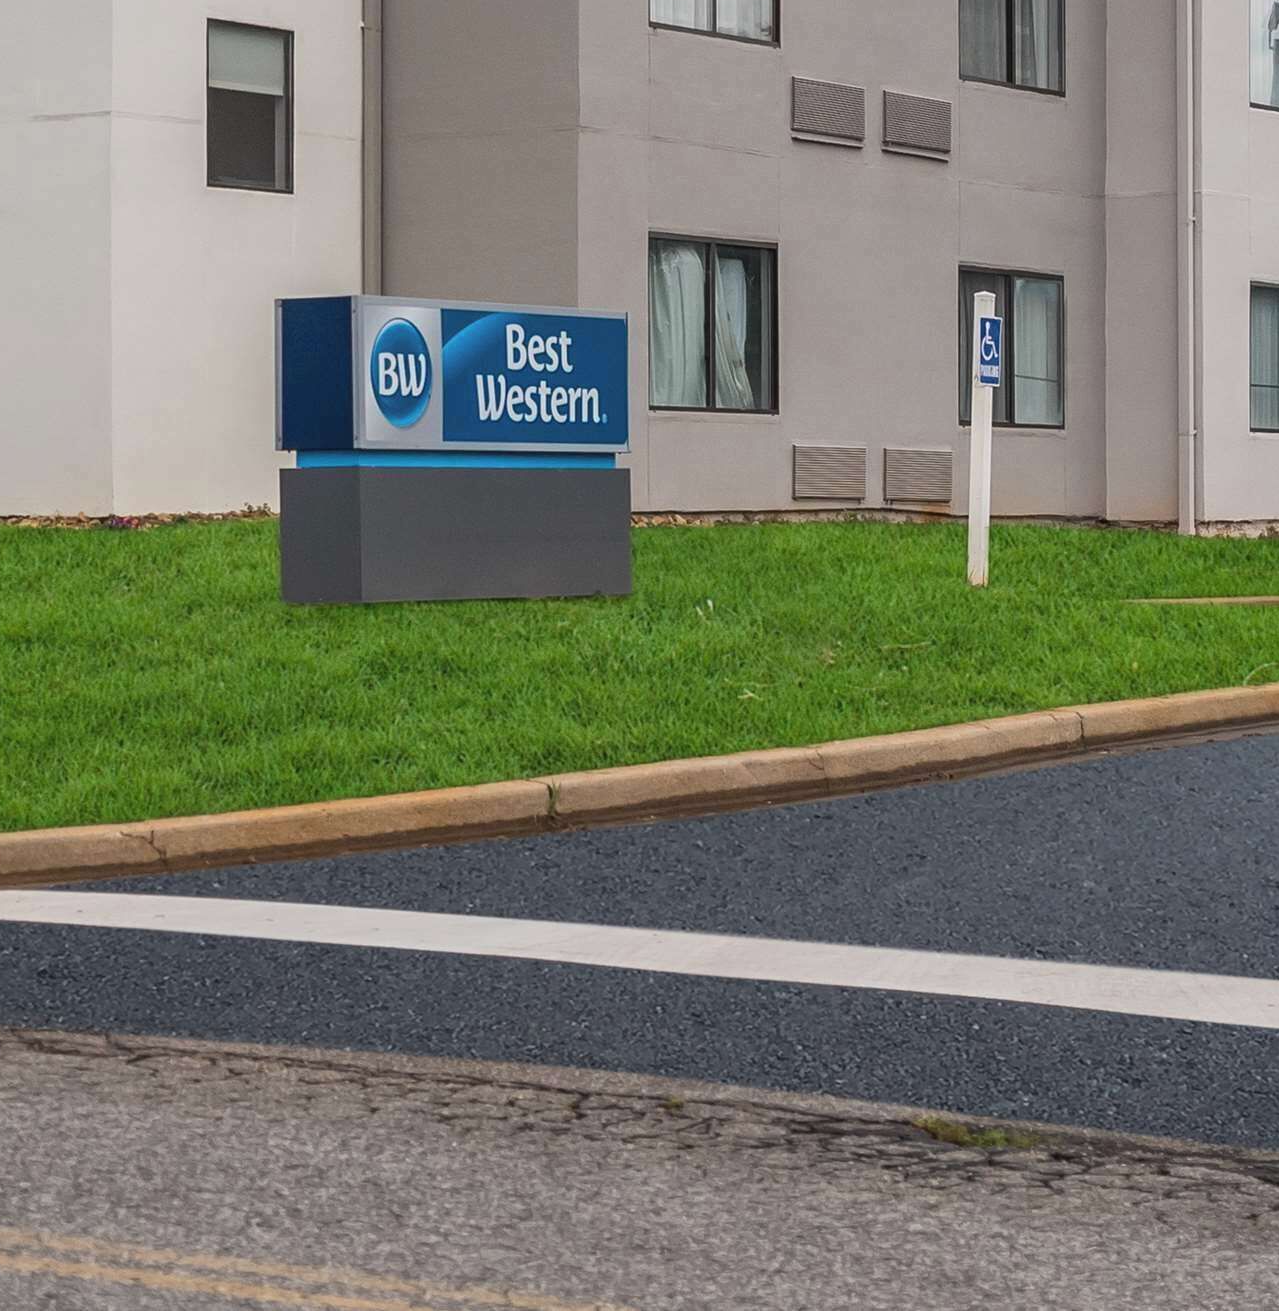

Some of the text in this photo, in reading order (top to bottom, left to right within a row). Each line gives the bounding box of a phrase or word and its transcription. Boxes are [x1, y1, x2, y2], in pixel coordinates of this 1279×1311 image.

[506, 324, 573, 373] Best
[378, 352, 427, 397] BW
[476, 374, 600, 424] Western
